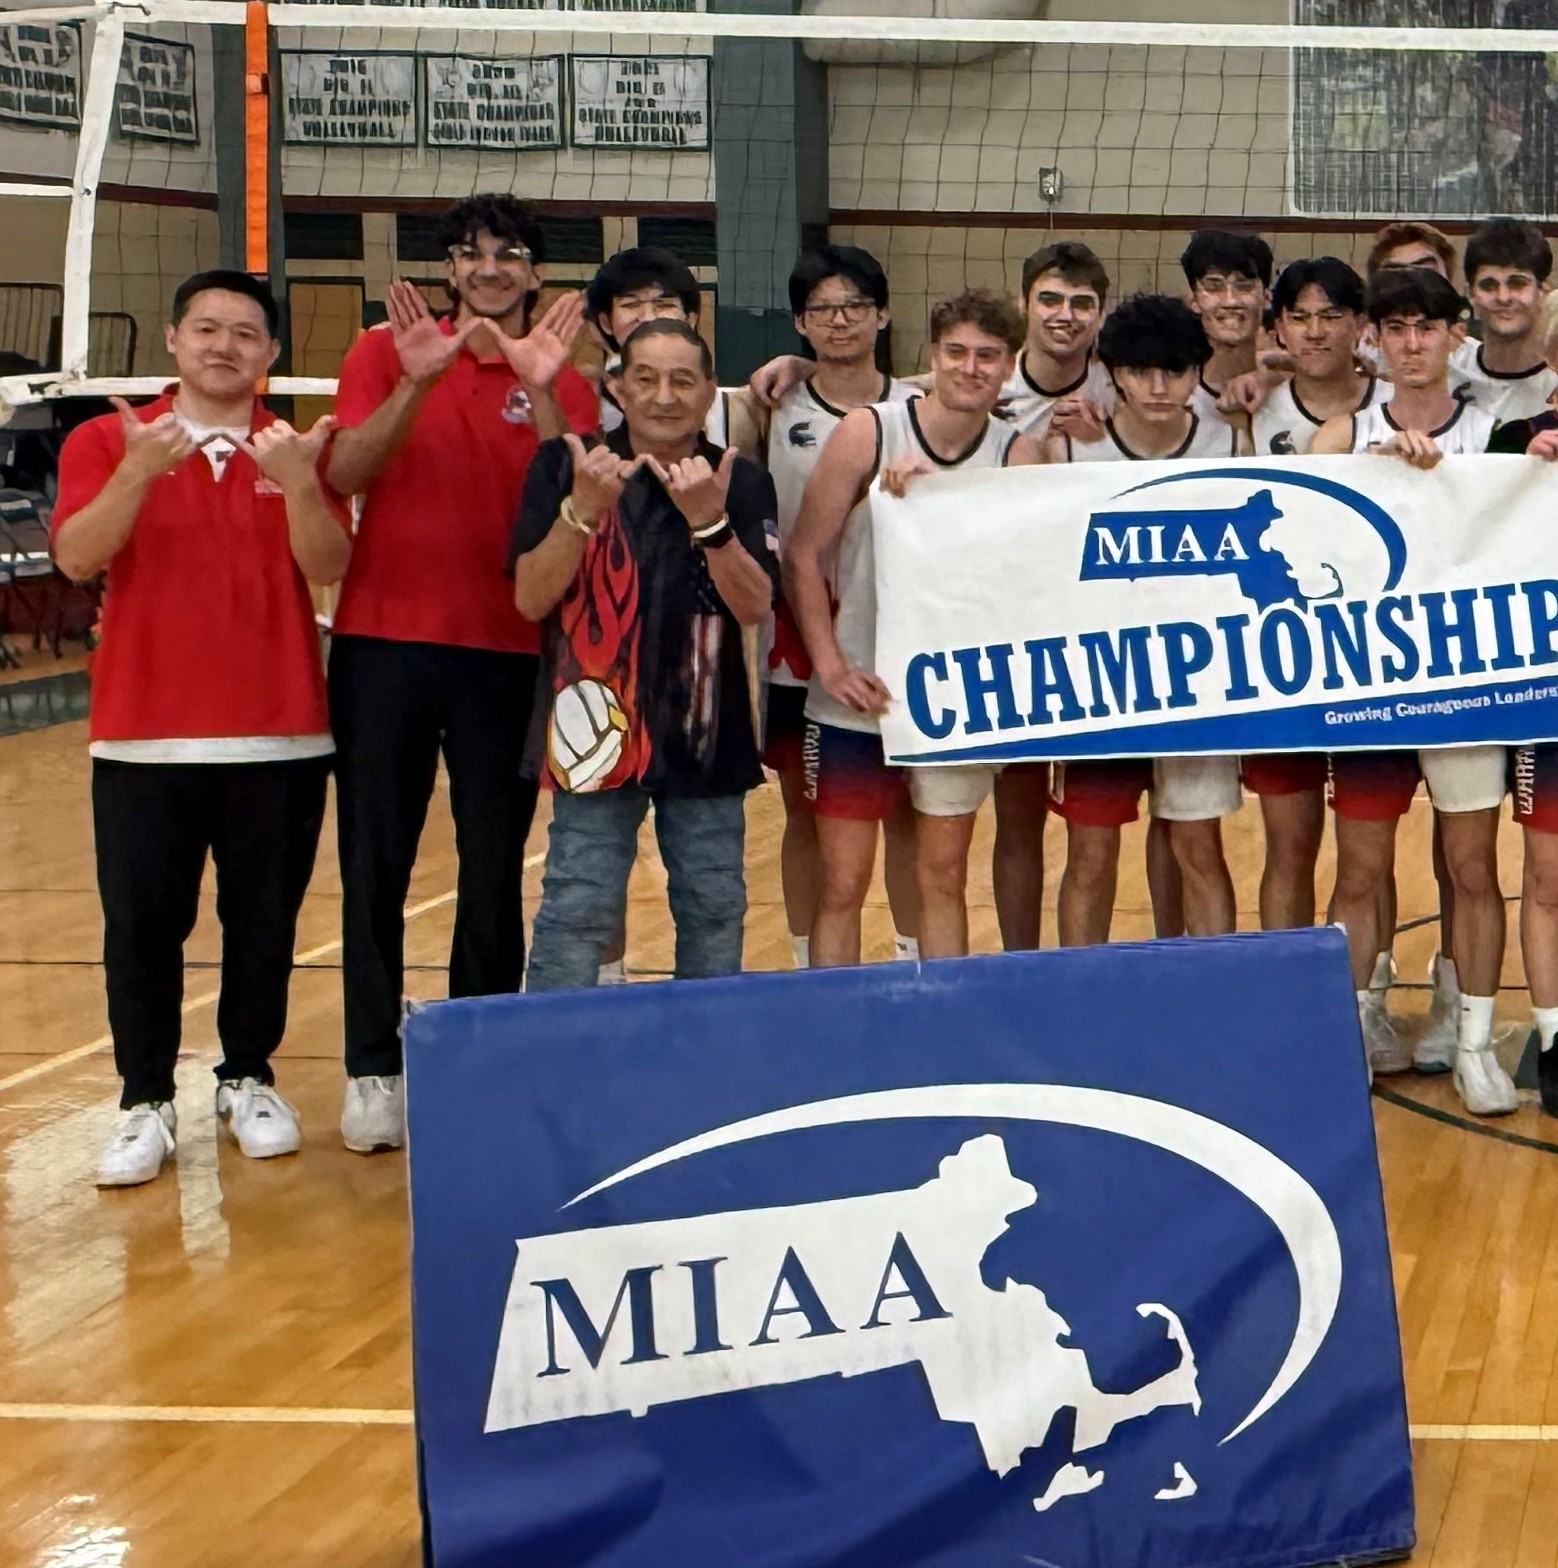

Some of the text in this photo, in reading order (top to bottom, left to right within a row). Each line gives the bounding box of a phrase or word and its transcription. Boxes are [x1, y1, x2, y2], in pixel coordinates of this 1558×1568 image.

[1095, 521, 1250, 566] MIAA
[1324, 705, 1392, 725] Growing
[529, 1231, 954, 1379] MIAA
